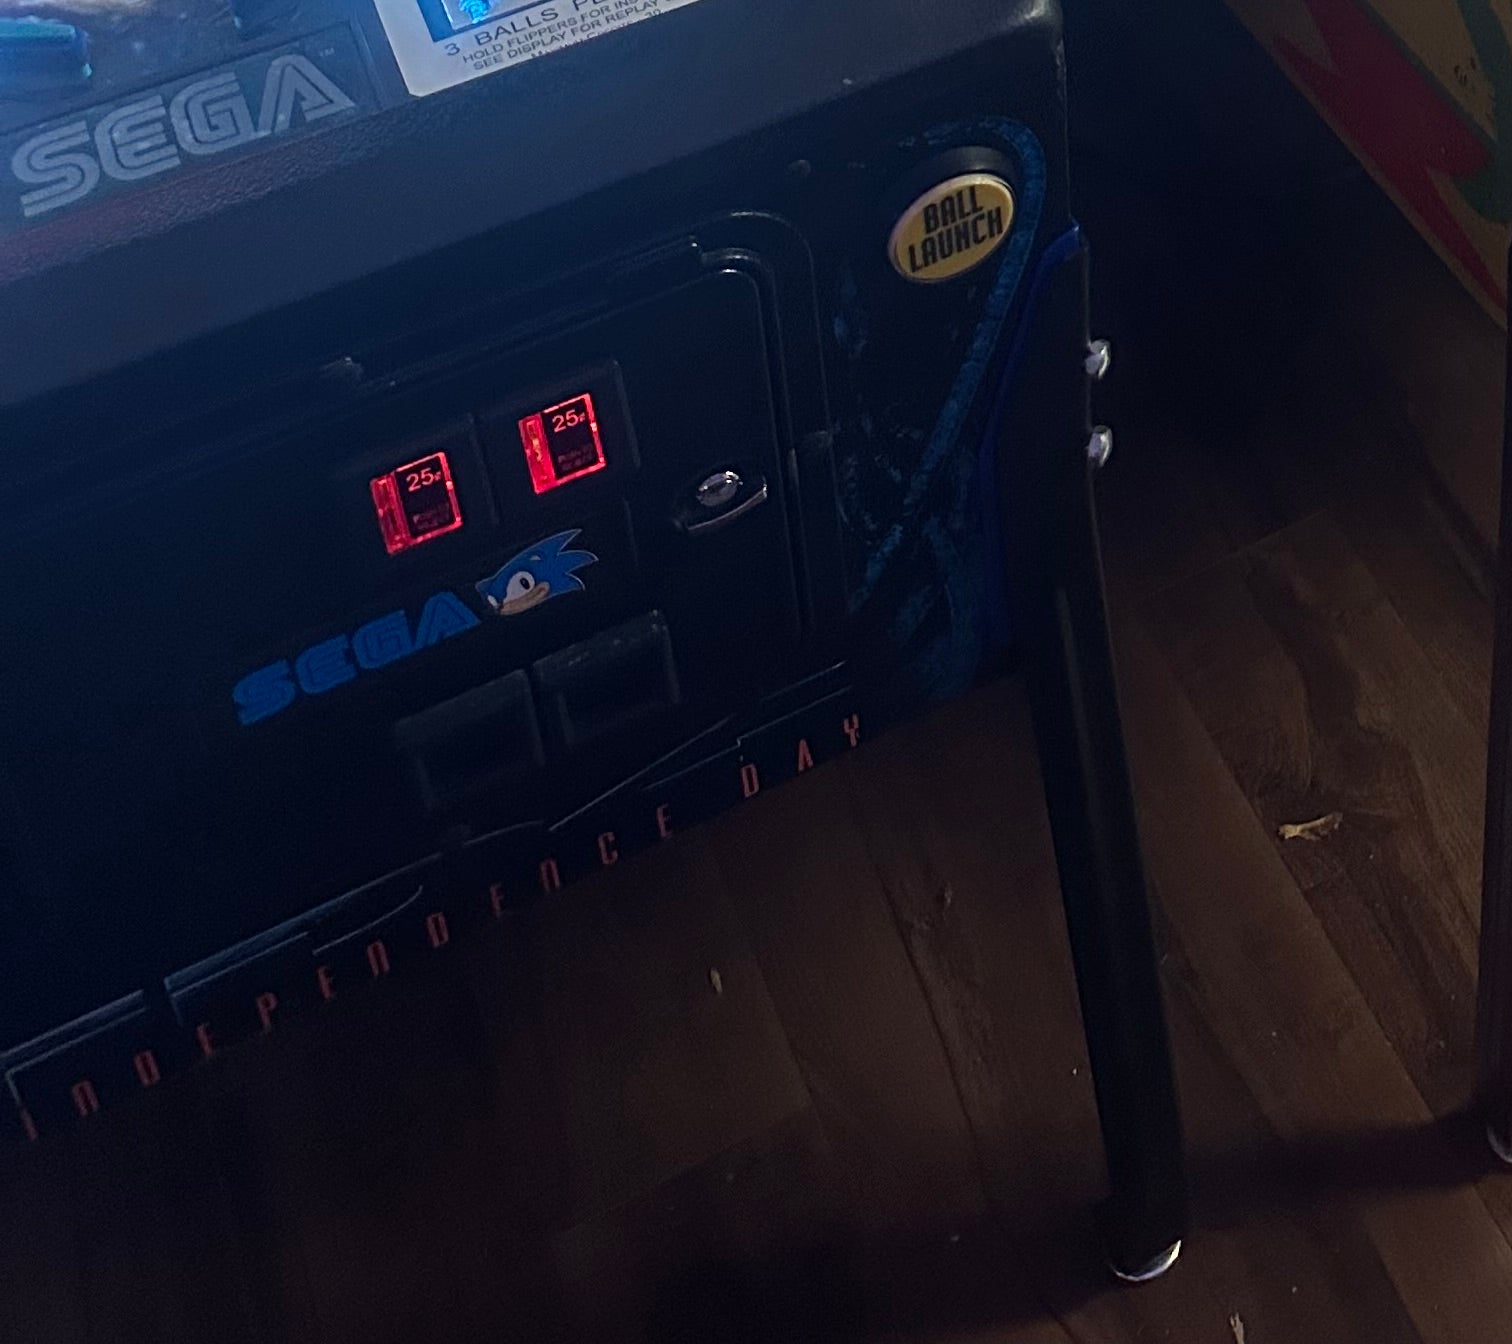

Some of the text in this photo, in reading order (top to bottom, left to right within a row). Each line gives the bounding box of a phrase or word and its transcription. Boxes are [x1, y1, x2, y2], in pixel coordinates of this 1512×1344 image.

[444, 42, 462, 56] 3
[473, 7, 560, 47] BALLS
[463, 43, 505, 64] HOLD
[506, 18, 579, 48] FLIPPERS
[580, 6, 613, 24] FOR
[472, 54, 505, 71] SEE
[506, 33, 567, 61] DISPLAY
[570, 19, 603, 39] FOR
[9, 52, 360, 217] SEGA
[924, 184, 984, 233] BALL
[907, 207, 1004, 273] LAUNCH
[231, 591, 482, 727] SEGA
[18, 715, 861, 1142] INDEPENDENCE DAY
